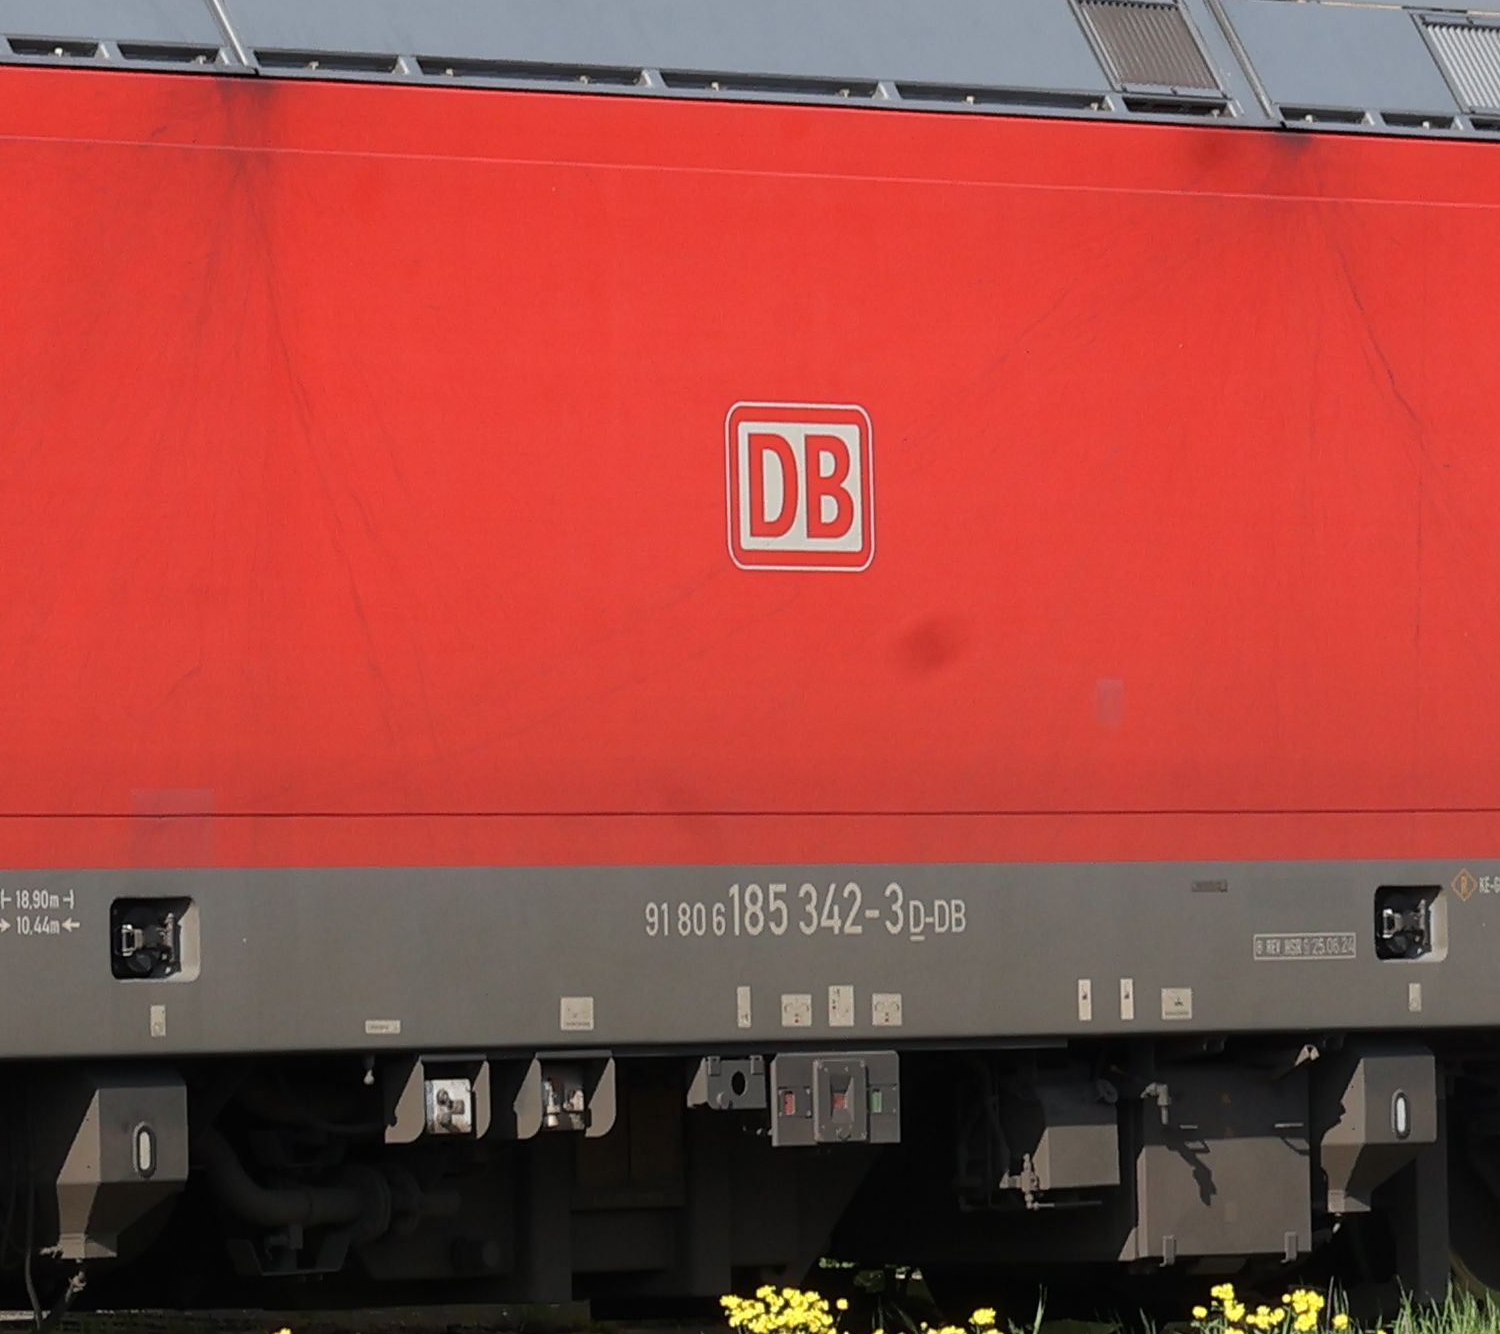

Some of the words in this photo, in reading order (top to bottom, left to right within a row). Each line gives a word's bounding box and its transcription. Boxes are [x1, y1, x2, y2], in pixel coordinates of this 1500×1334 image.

[747, 432, 855, 539] DB
[645, 901, 669, 936] 91
[677, 901, 706, 936] 80
[798, 882, 904, 935] 342-3
